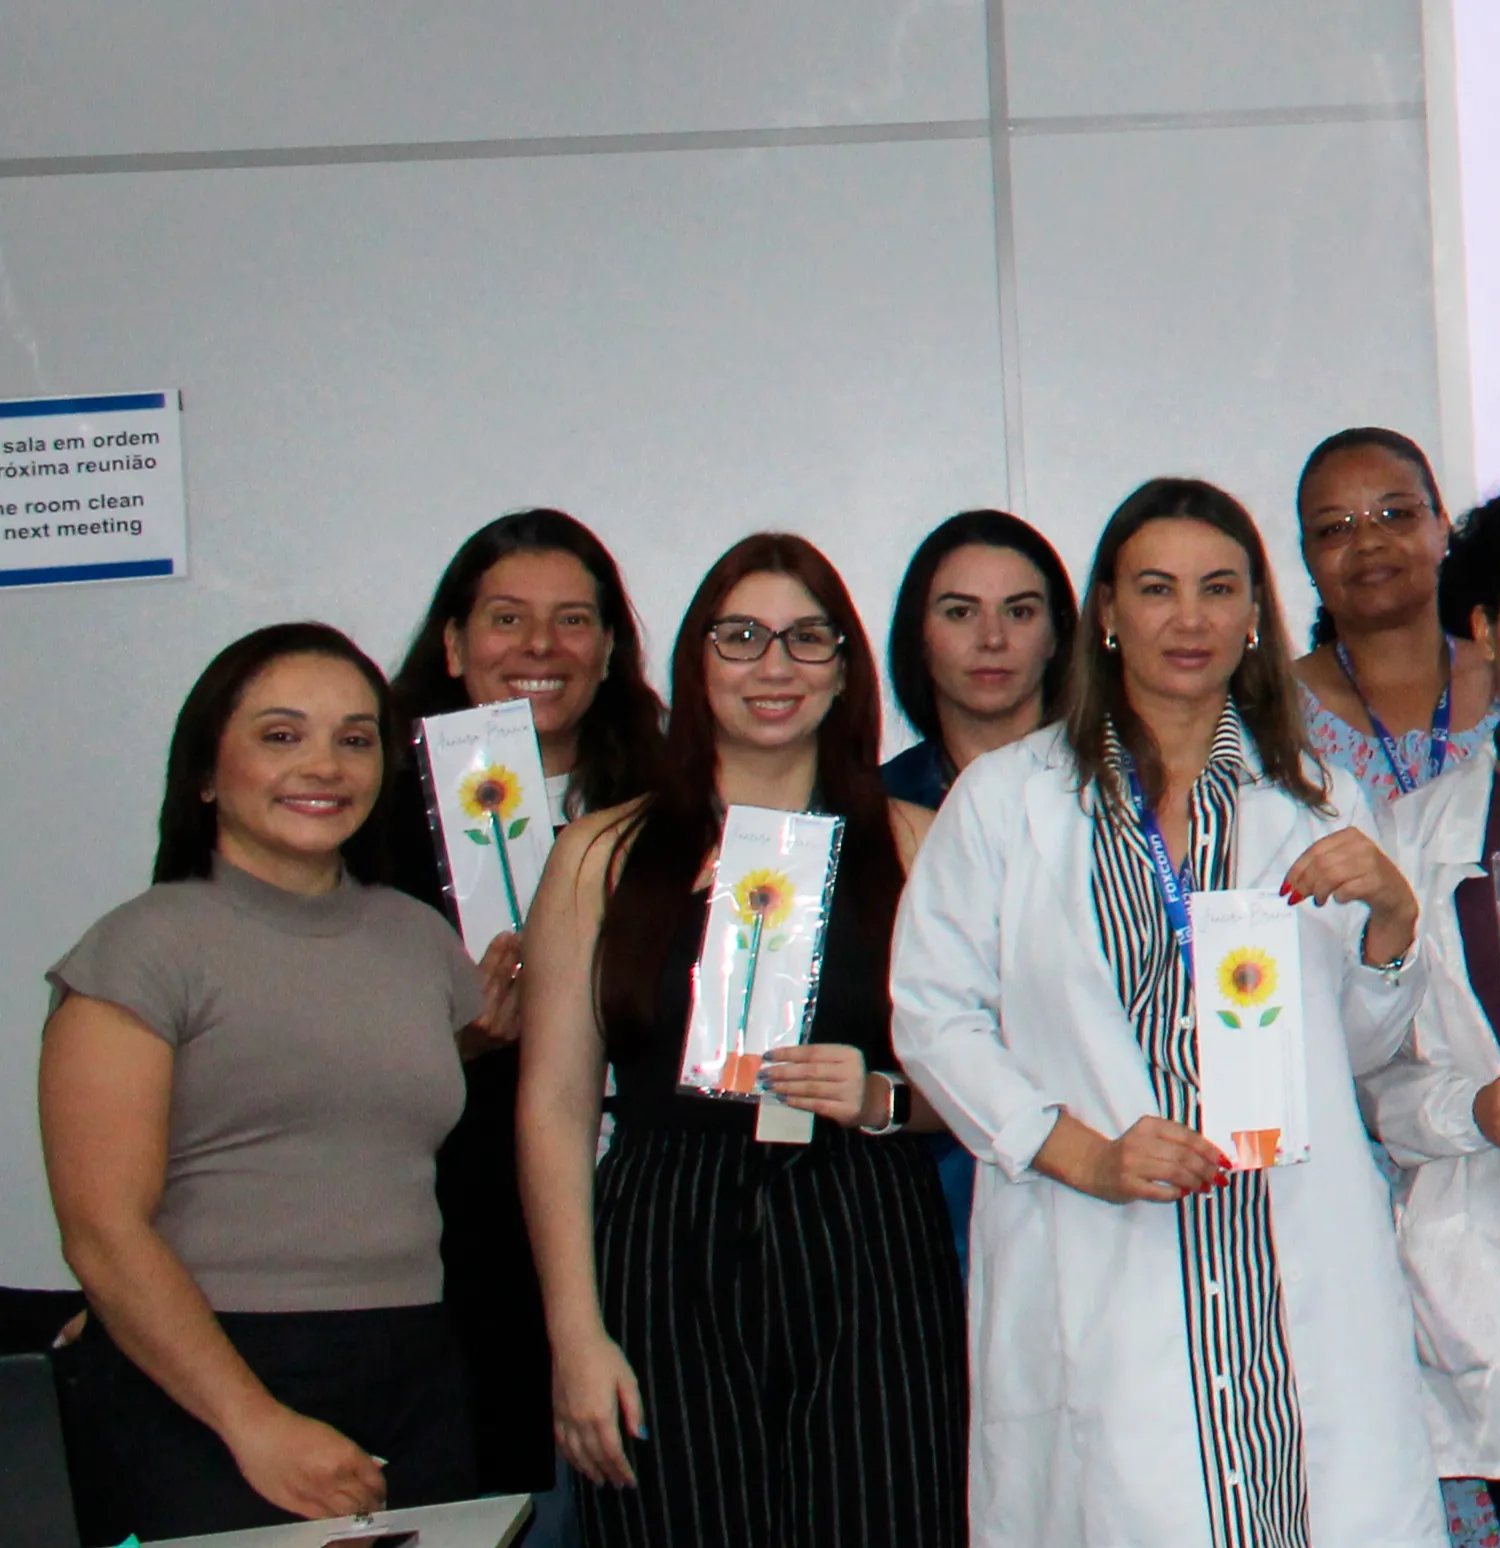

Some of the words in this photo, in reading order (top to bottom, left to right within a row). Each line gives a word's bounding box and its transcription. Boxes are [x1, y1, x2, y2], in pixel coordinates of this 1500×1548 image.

[2, 437, 46, 455] sala
[54, 434, 85, 451] em
[93, 430, 160, 448] ordem
[76, 454, 157, 474] reunião
[25, 496, 81, 515] room
[88, 493, 145, 511] clean
[4, 522, 50, 540] next
[57, 517, 143, 538] meeting
